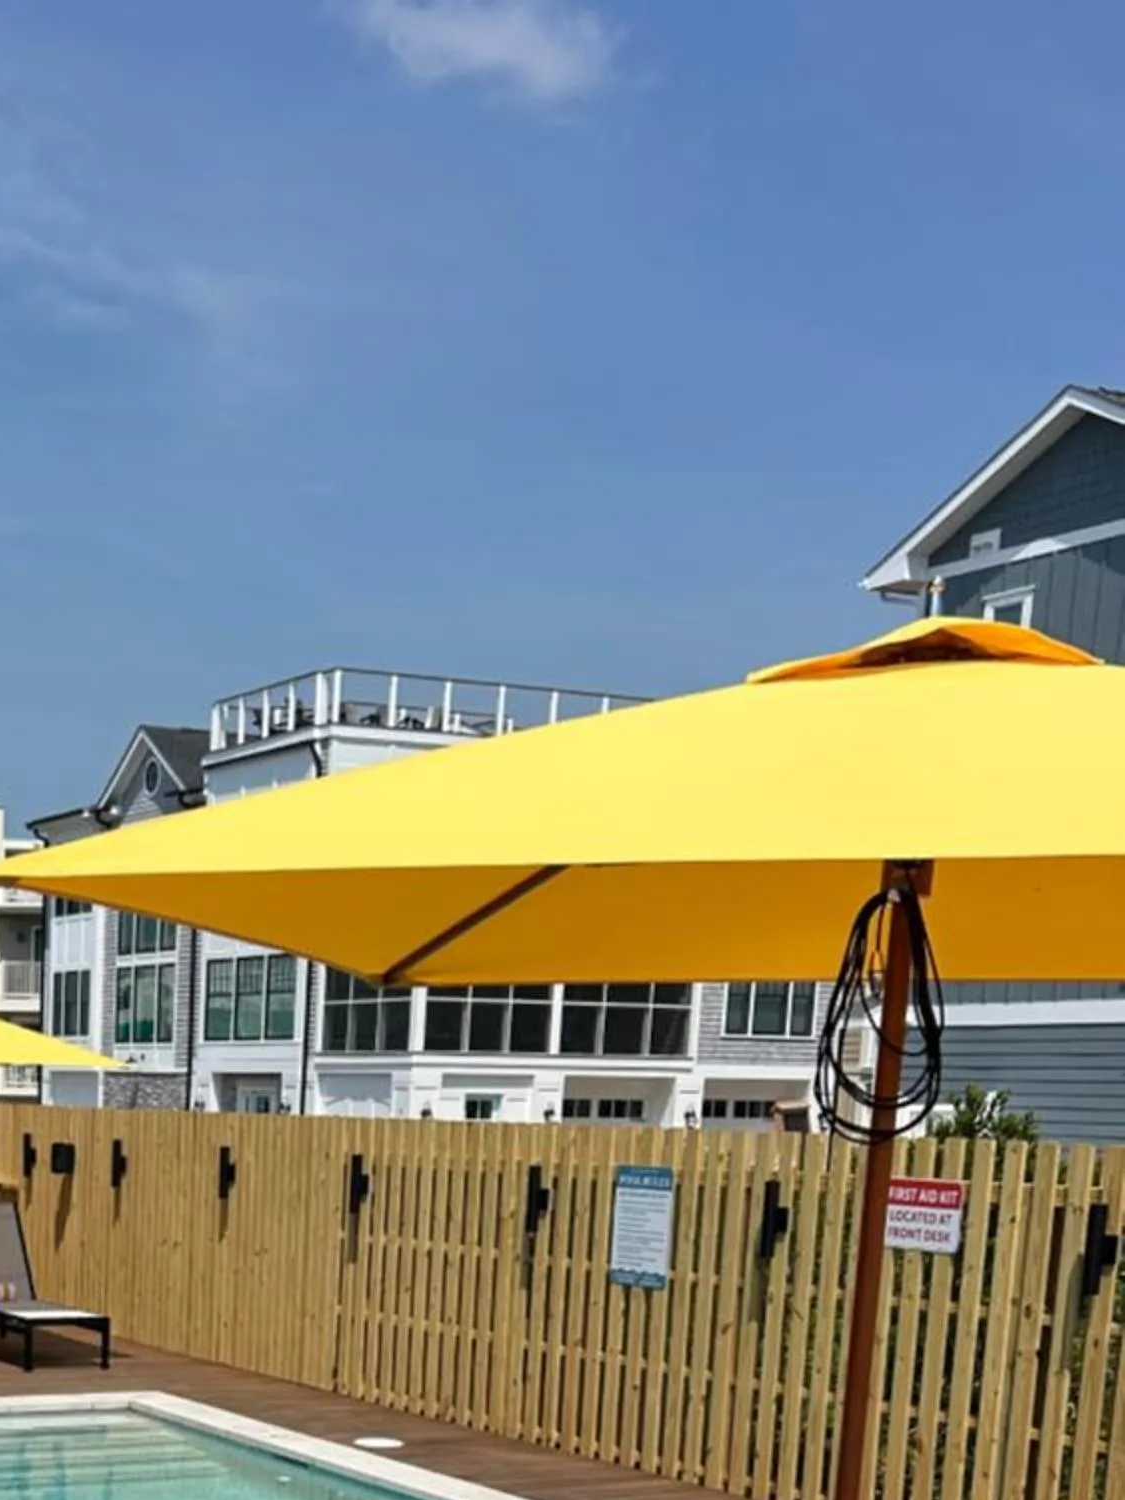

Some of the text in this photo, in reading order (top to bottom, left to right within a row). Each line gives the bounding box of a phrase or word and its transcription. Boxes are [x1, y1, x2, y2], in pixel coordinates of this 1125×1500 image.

[918, 1187, 938, 1204] AID
[939, 1189, 959, 1205] KIT
[889, 1209, 952, 1225] LOCATED AT
[888, 1226, 951, 1243] FRONT DESK
